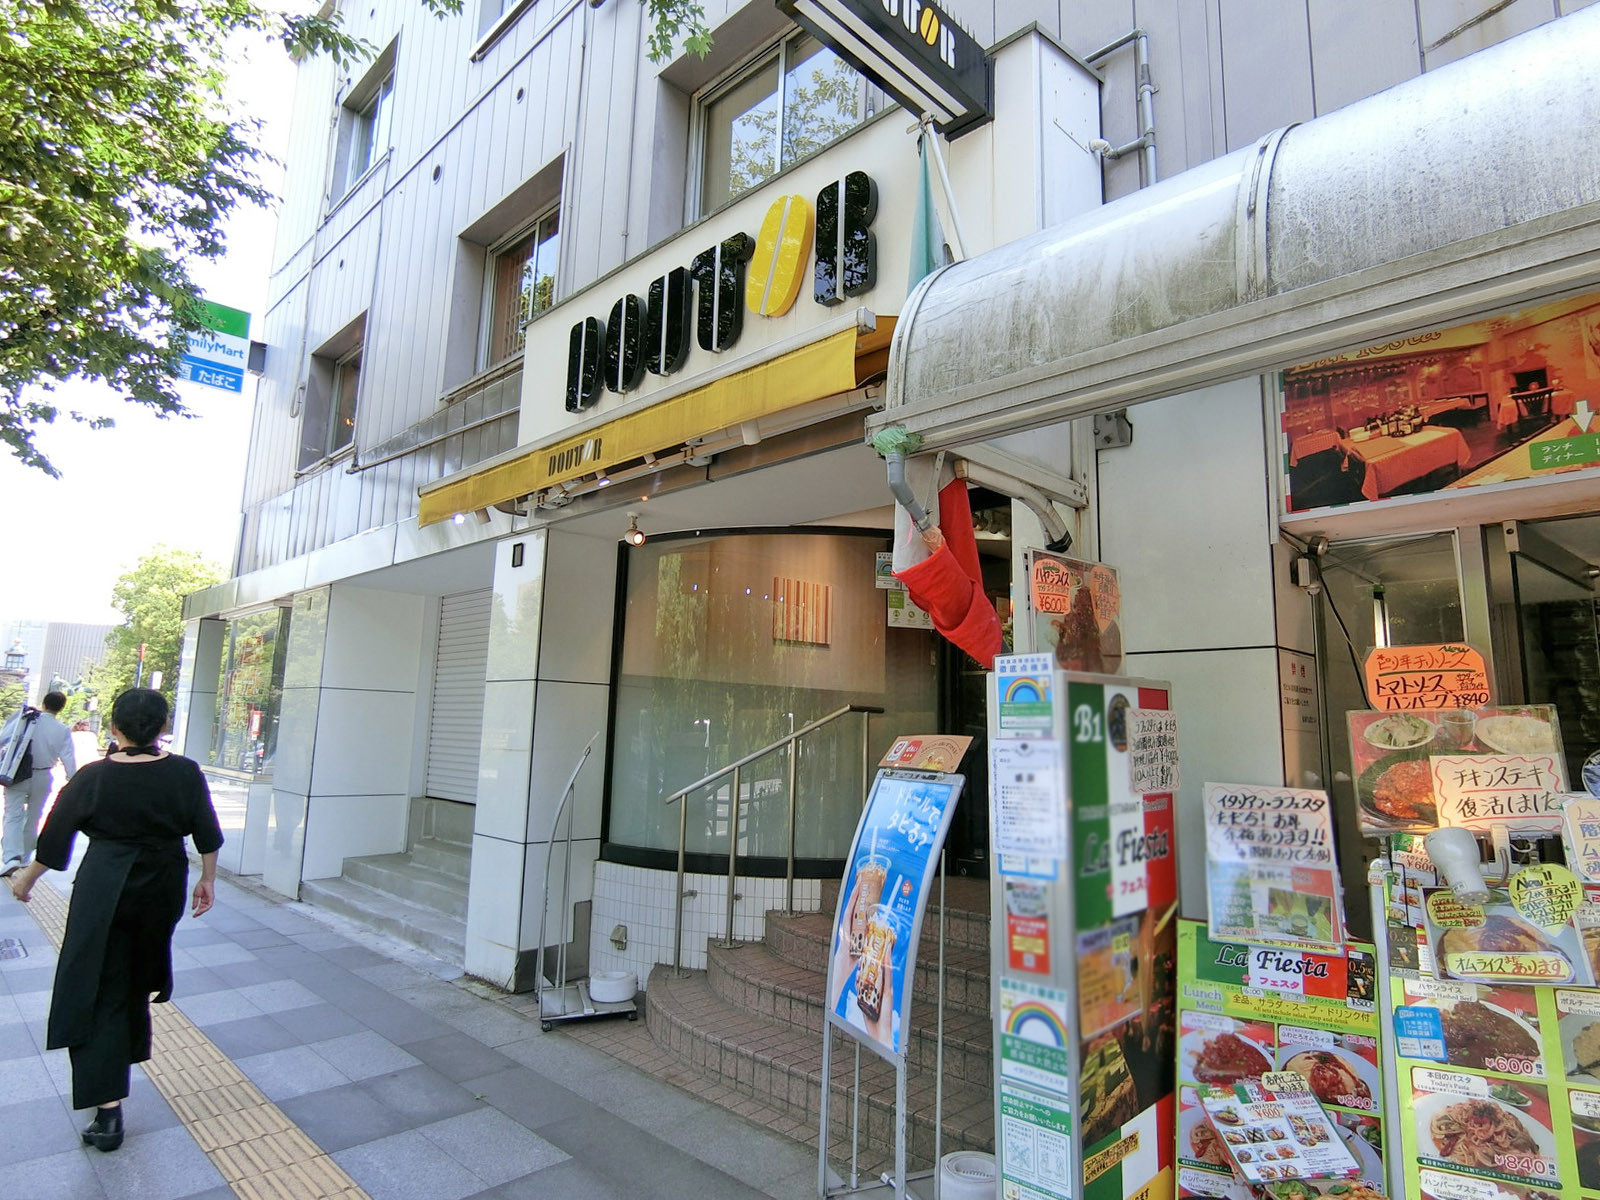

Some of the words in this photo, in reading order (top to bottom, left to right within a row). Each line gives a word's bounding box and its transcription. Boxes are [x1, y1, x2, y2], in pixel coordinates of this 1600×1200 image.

[566, 170, 879, 413] DOUTOR
[198, 370, 236, 390] たばこ
[548, 437, 602, 477] DOUTOR
[1541, 442, 1574, 454] ランチ
[1541, 452, 1585, 464] ディナー
[1375, 674, 1446, 696] トマトソース
[1386, 690, 1453, 710] ハンバーグ
[1453, 692, 1489, 708] ¥840
[1074, 703, 1103, 743] B1
[1452, 765, 1544, 788] チキンステーキ
[1217, 793, 1326, 813] イタリアン・ラフェスタ
[1455, 791, 1558, 819] 復活しました
[1116, 825, 1170, 868] Fiesta
[1215, 944, 1249, 967] La
[1256, 950, 1329, 978] Fiesta
[1456, 957, 1506, 973] オムライス
[1511, 958, 1562, 976] あります
[1183, 984, 1223, 1001] Lunch
[1259, 976, 1300, 990] フェスタ
[1418, 983, 1463, 994] ハヤシライス
[1195, 1000, 1223, 1013] Menu
[1232, 993, 1370, 1023] 全品、サラダ・スープ・ドリンク付
[1485, 1057, 1534, 1075] ¥600
[1426, 1071, 1472, 1084] 本日のパスタ
[1337, 1094, 1373, 1111] ¥840
[1494, 1155, 1546, 1175] ¥840
[1424, 1178, 1495, 1197] ハンバーグステーキ
